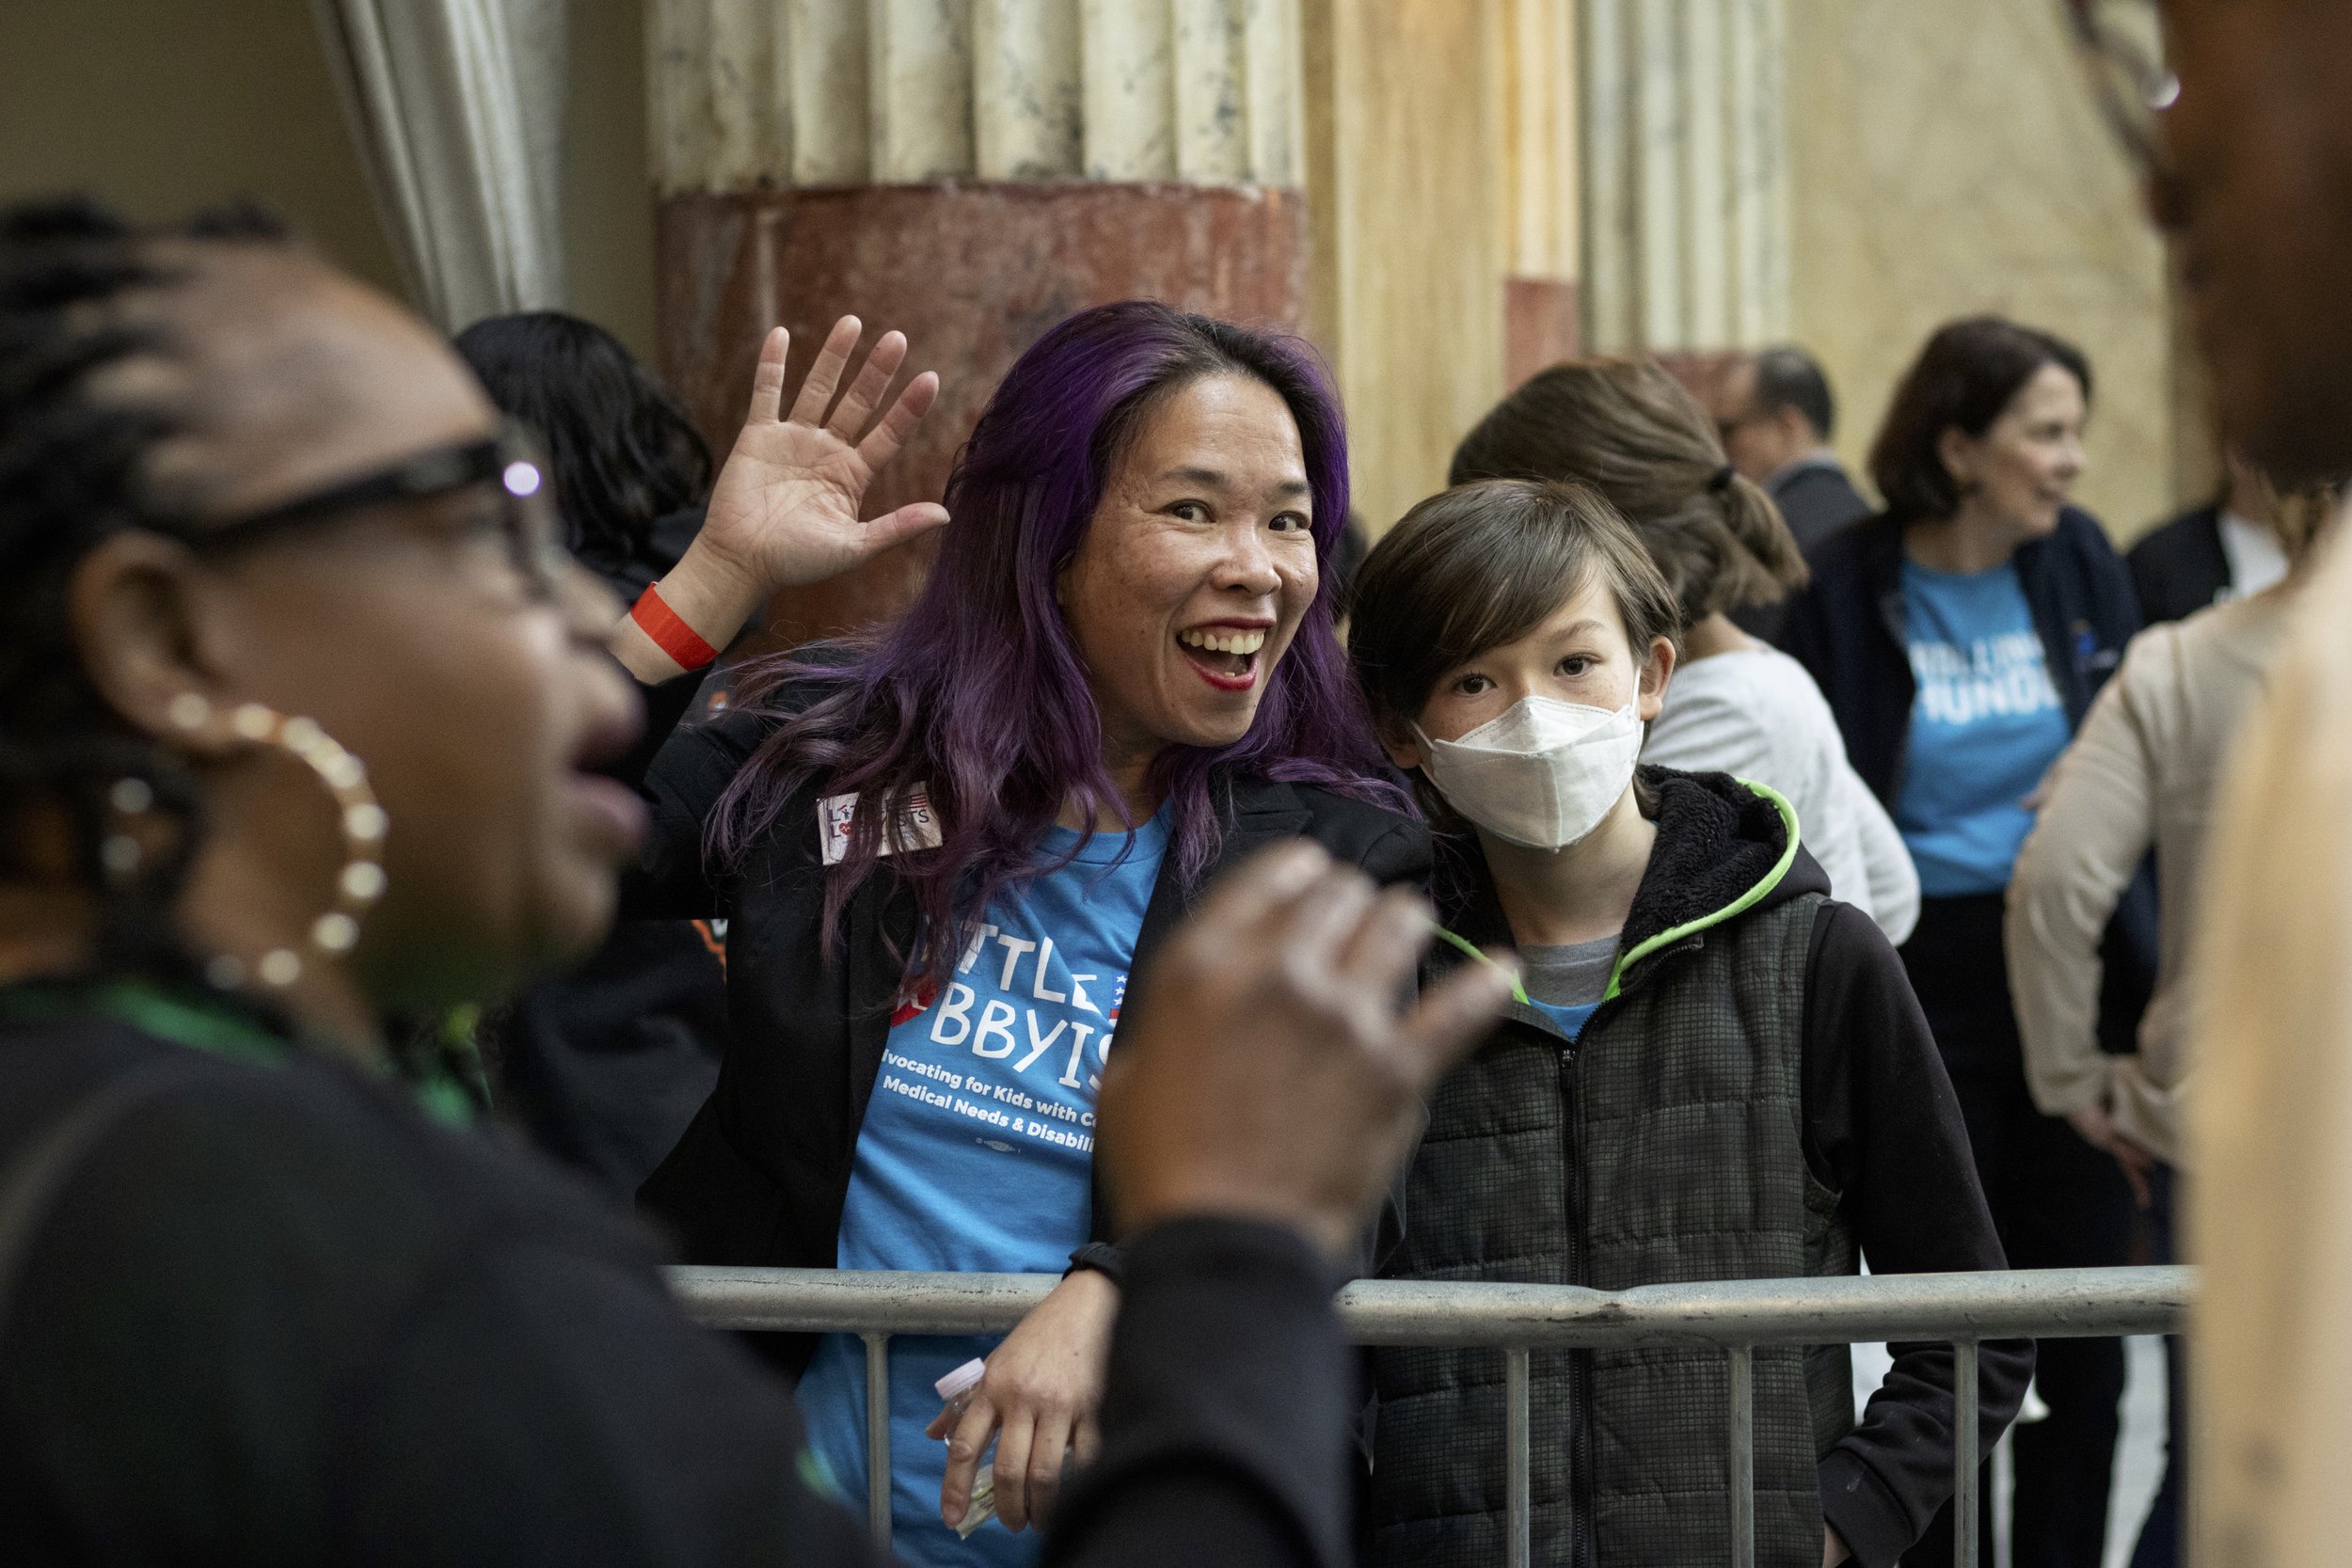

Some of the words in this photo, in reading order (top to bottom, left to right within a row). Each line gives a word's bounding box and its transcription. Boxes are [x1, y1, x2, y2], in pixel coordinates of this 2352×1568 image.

[882, 1075, 952, 1109] Medical
[953, 1099, 1009, 1127] Needs
[1011, 1117, 1025, 1132] &
[965, 1076, 992, 1096] for
[993, 1085, 1033, 1109] Kids
[1036, 1101, 1077, 1123] with
